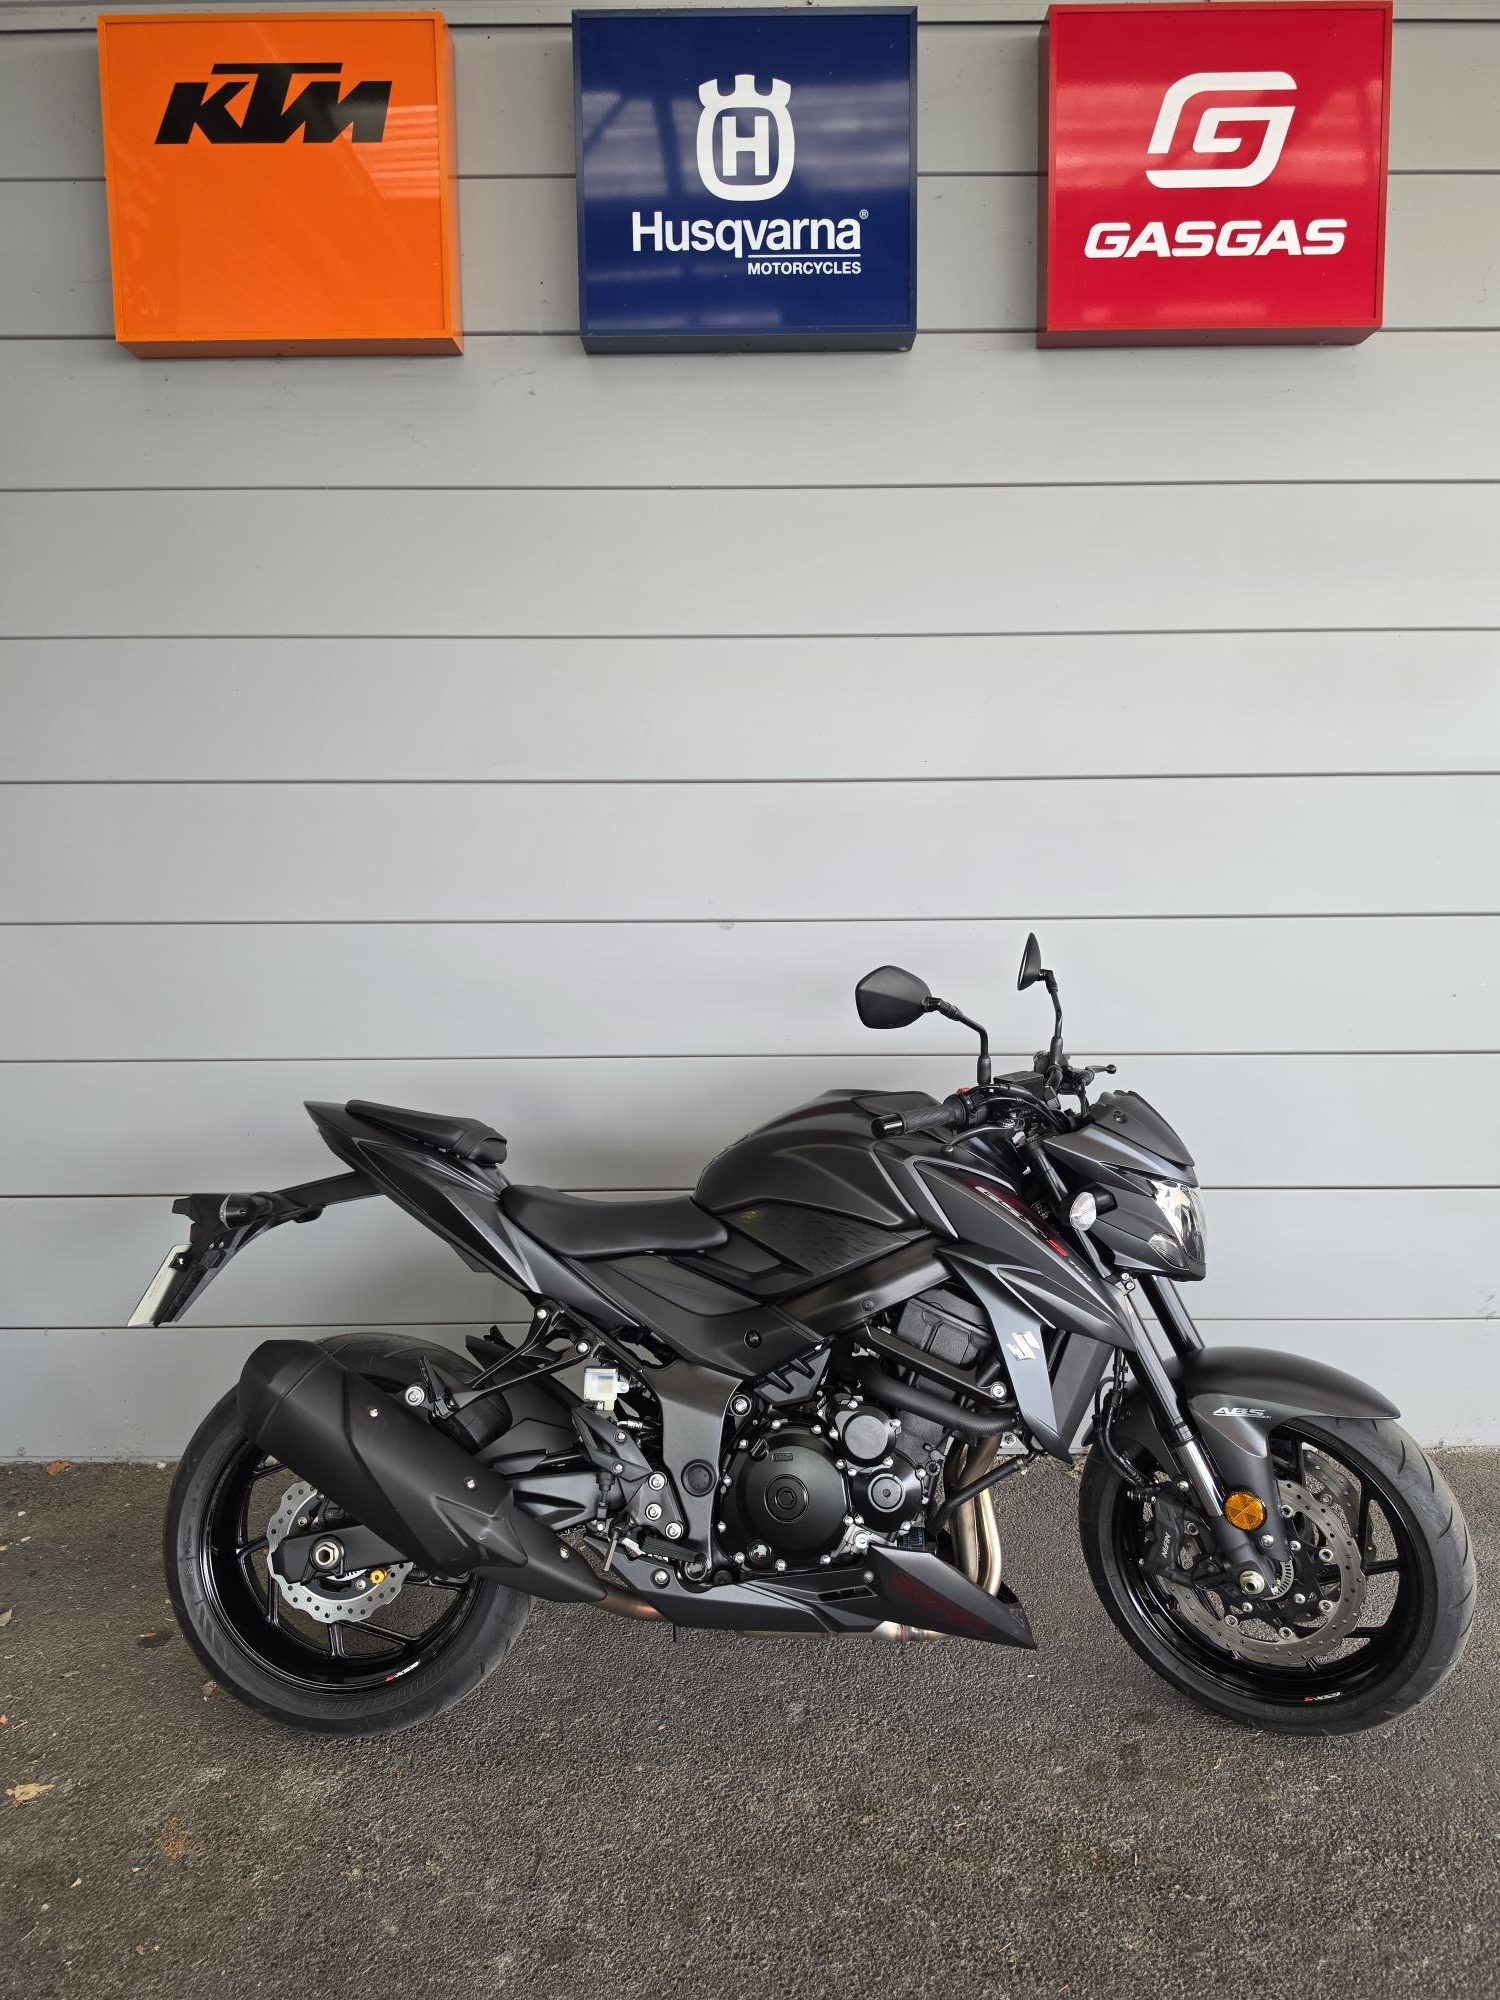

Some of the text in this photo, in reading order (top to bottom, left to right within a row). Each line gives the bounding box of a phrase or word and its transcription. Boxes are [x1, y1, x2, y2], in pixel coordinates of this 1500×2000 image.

[155, 62, 393, 144] KTM
[1084, 218, 1348, 259] GASGAS
[747, 261, 862, 275] MOTORCYCLES
[1212, 1406, 1266, 1419] ABS
